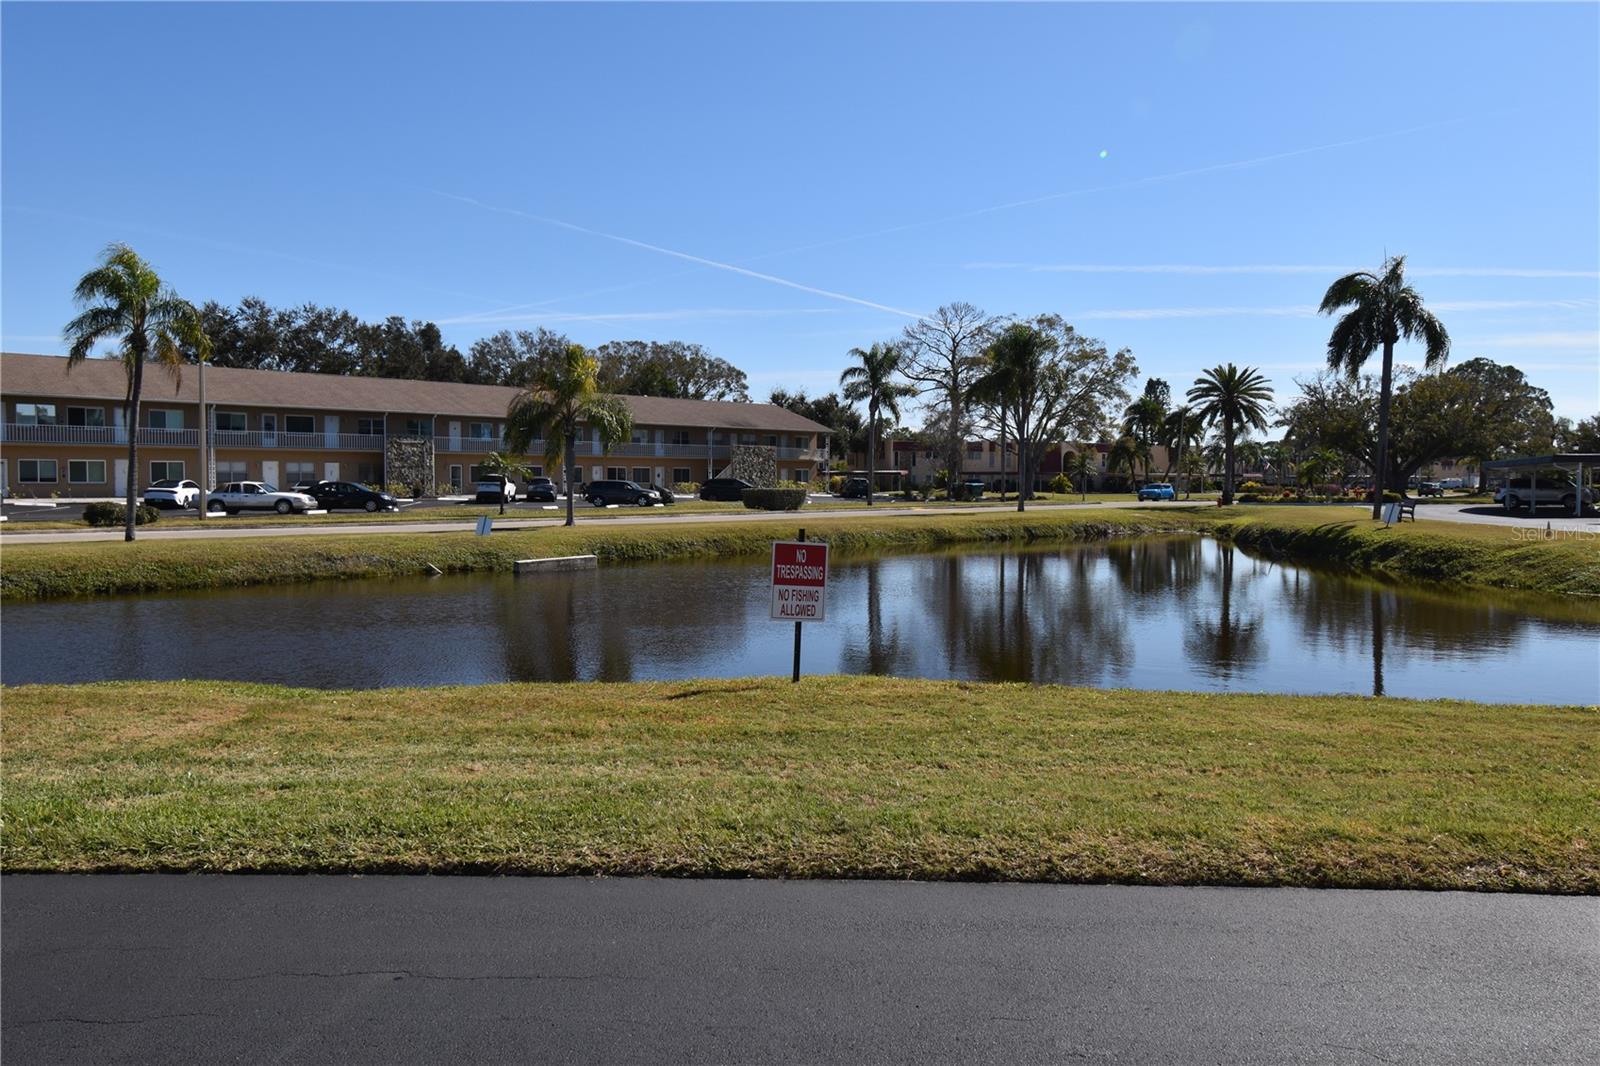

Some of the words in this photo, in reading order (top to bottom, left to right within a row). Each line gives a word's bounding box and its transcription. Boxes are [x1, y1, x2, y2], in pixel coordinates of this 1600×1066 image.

[796, 549, 807, 563] NO
[777, 565, 823, 580] TRESPASSING
[778, 589, 790, 601] NO
[791, 589, 819, 602] FISHING
[780, 603, 816, 617] ALLOWED
